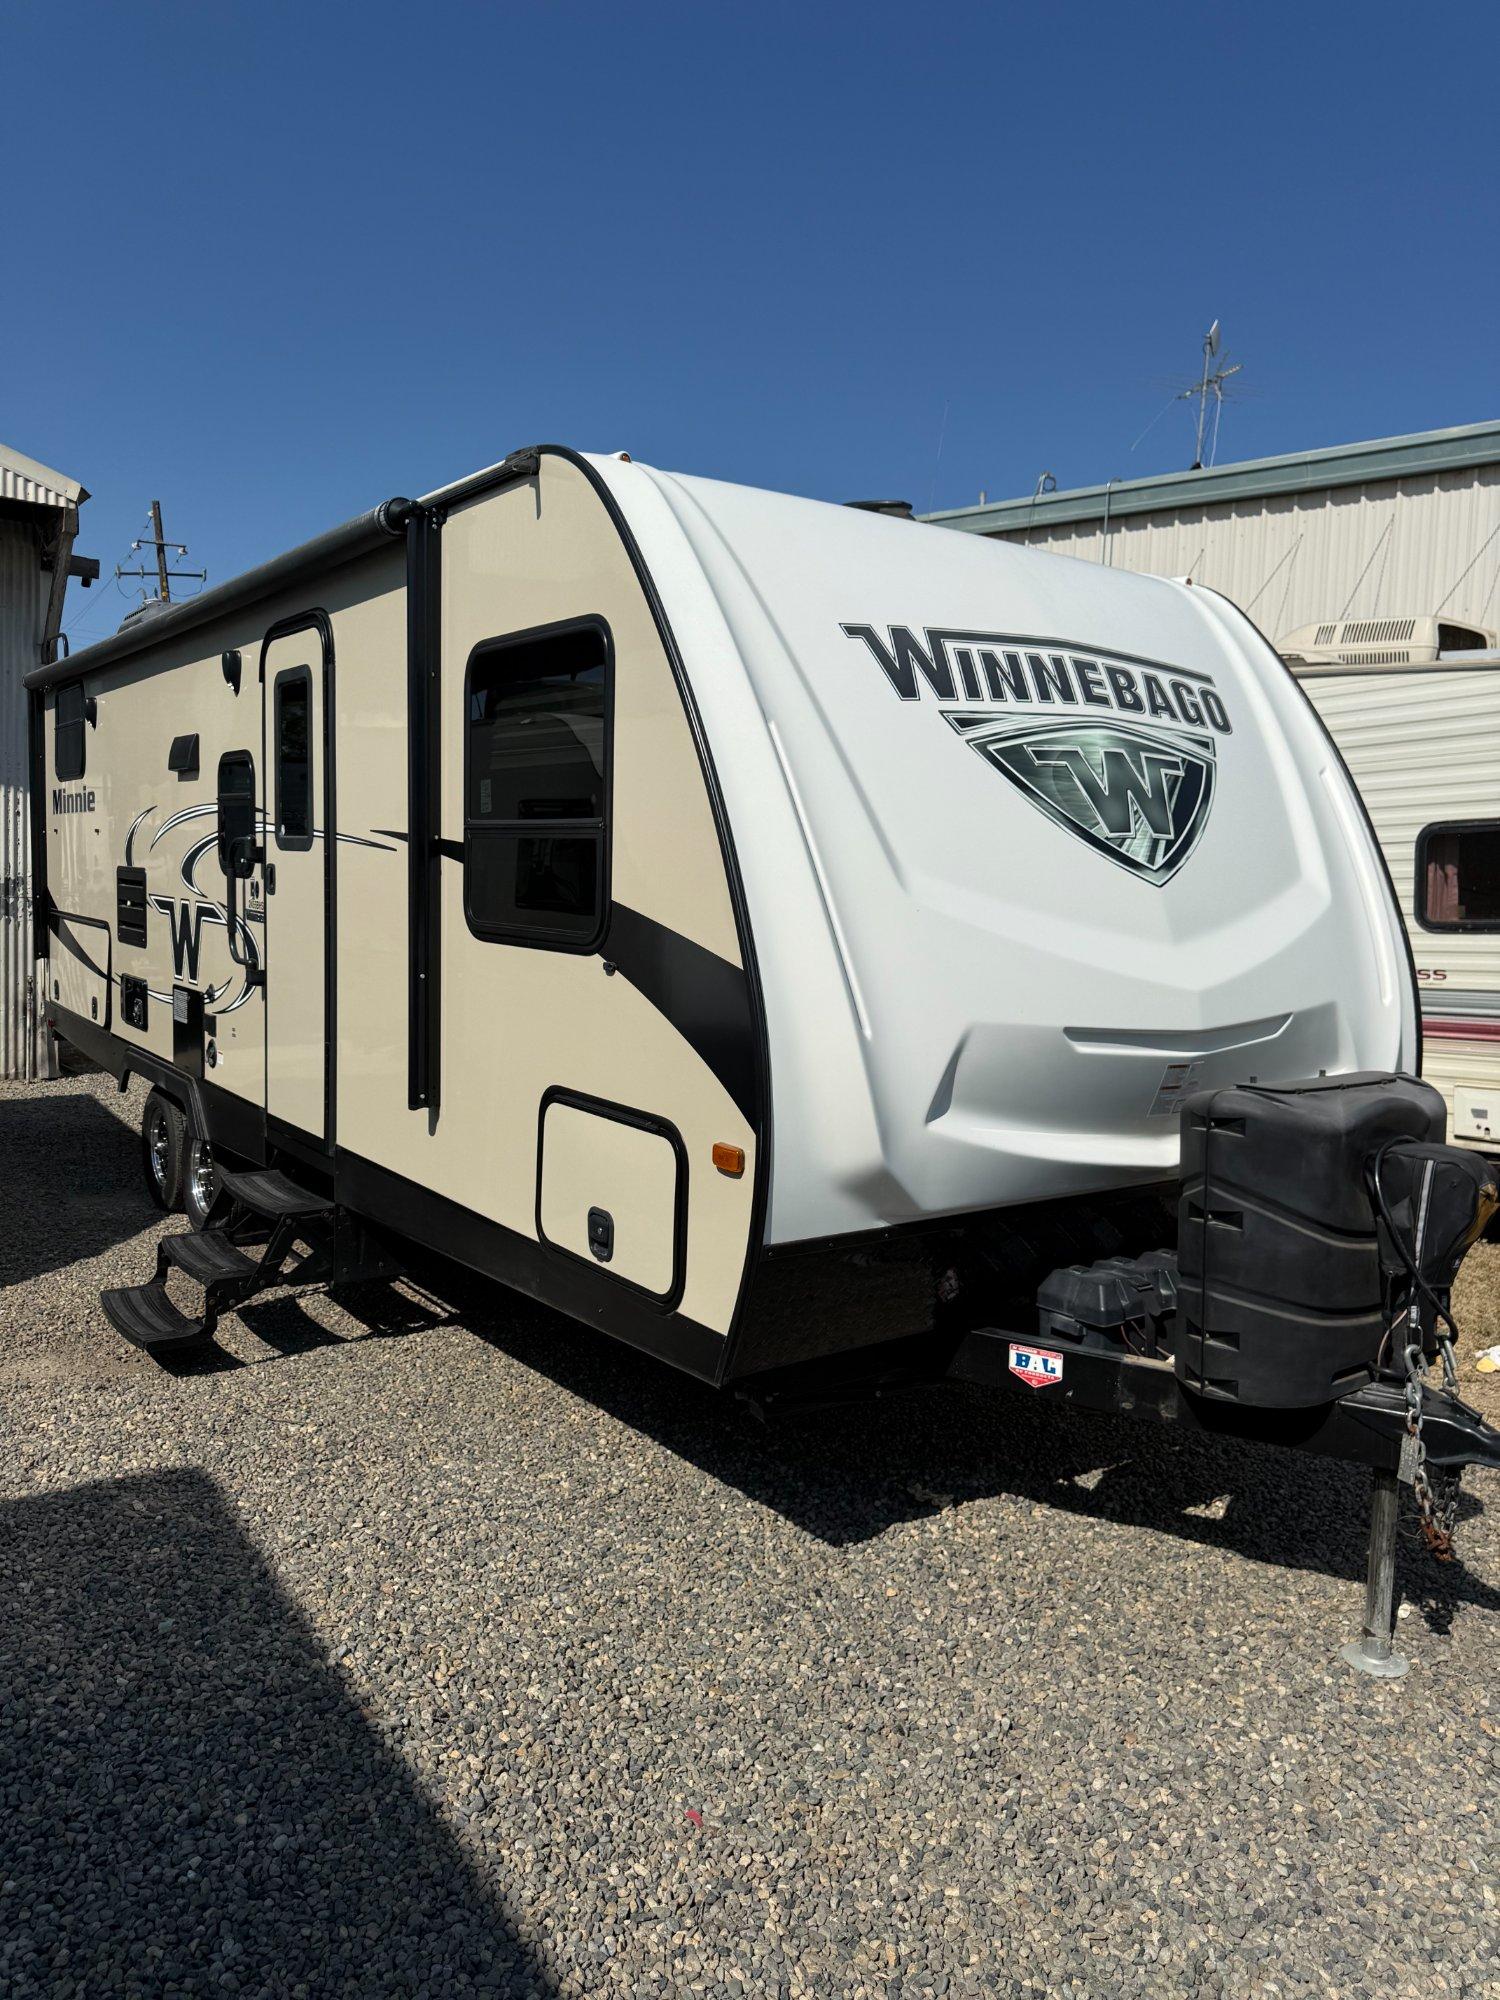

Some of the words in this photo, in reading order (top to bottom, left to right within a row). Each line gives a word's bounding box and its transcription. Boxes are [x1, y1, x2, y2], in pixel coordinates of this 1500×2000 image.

[839, 622, 1233, 736] WINNEBAGO
[53, 785, 96, 815] Minnie
[1026, 744, 1186, 840] W
